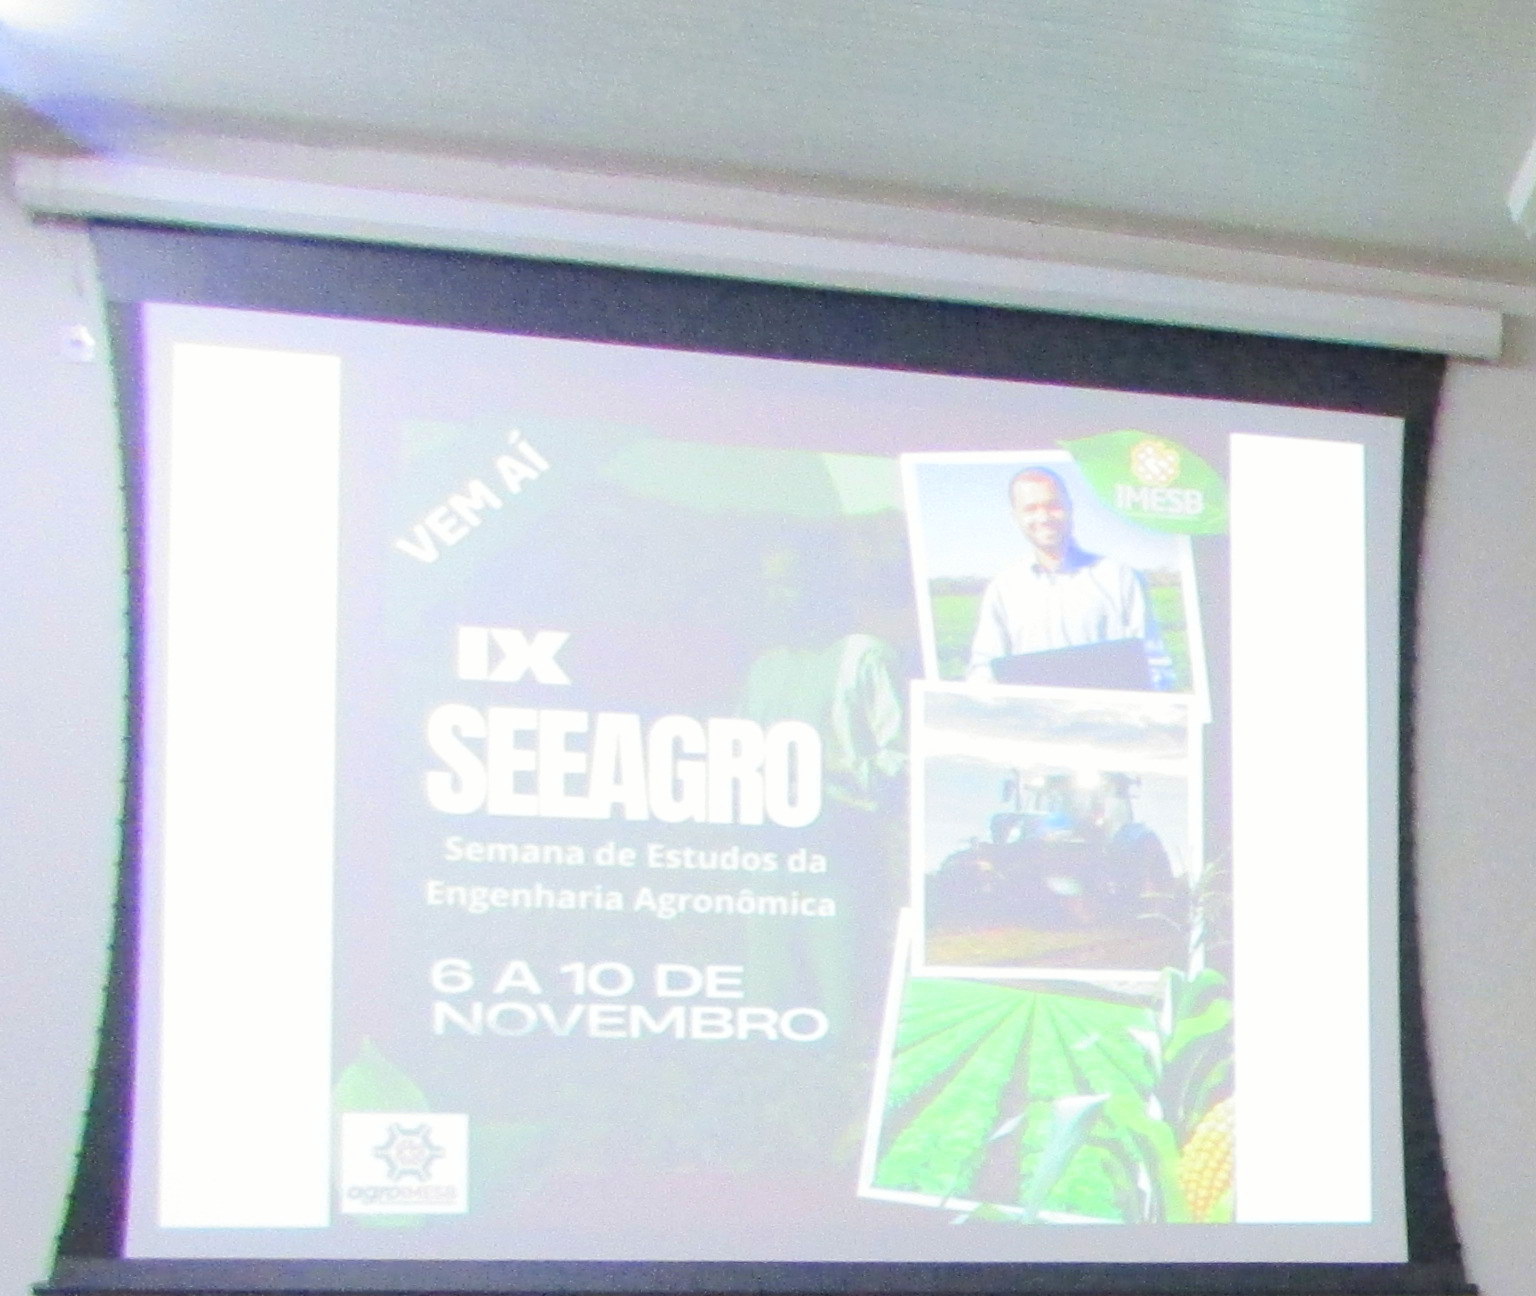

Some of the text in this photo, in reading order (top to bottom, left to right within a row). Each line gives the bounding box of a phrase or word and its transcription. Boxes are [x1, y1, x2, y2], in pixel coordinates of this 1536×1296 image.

[395, 428, 550, 563] VEM AÍ
[457, 625, 572, 685] IX
[426, 703, 822, 828] SEEAGRO
[444, 835, 828, 873] Semana de Estudos da
[425, 880, 837, 919] Engenharia Agronômica
[430, 958, 745, 999] 6 A 10 DE
[431, 1000, 830, 1042] NOVEMBRO
